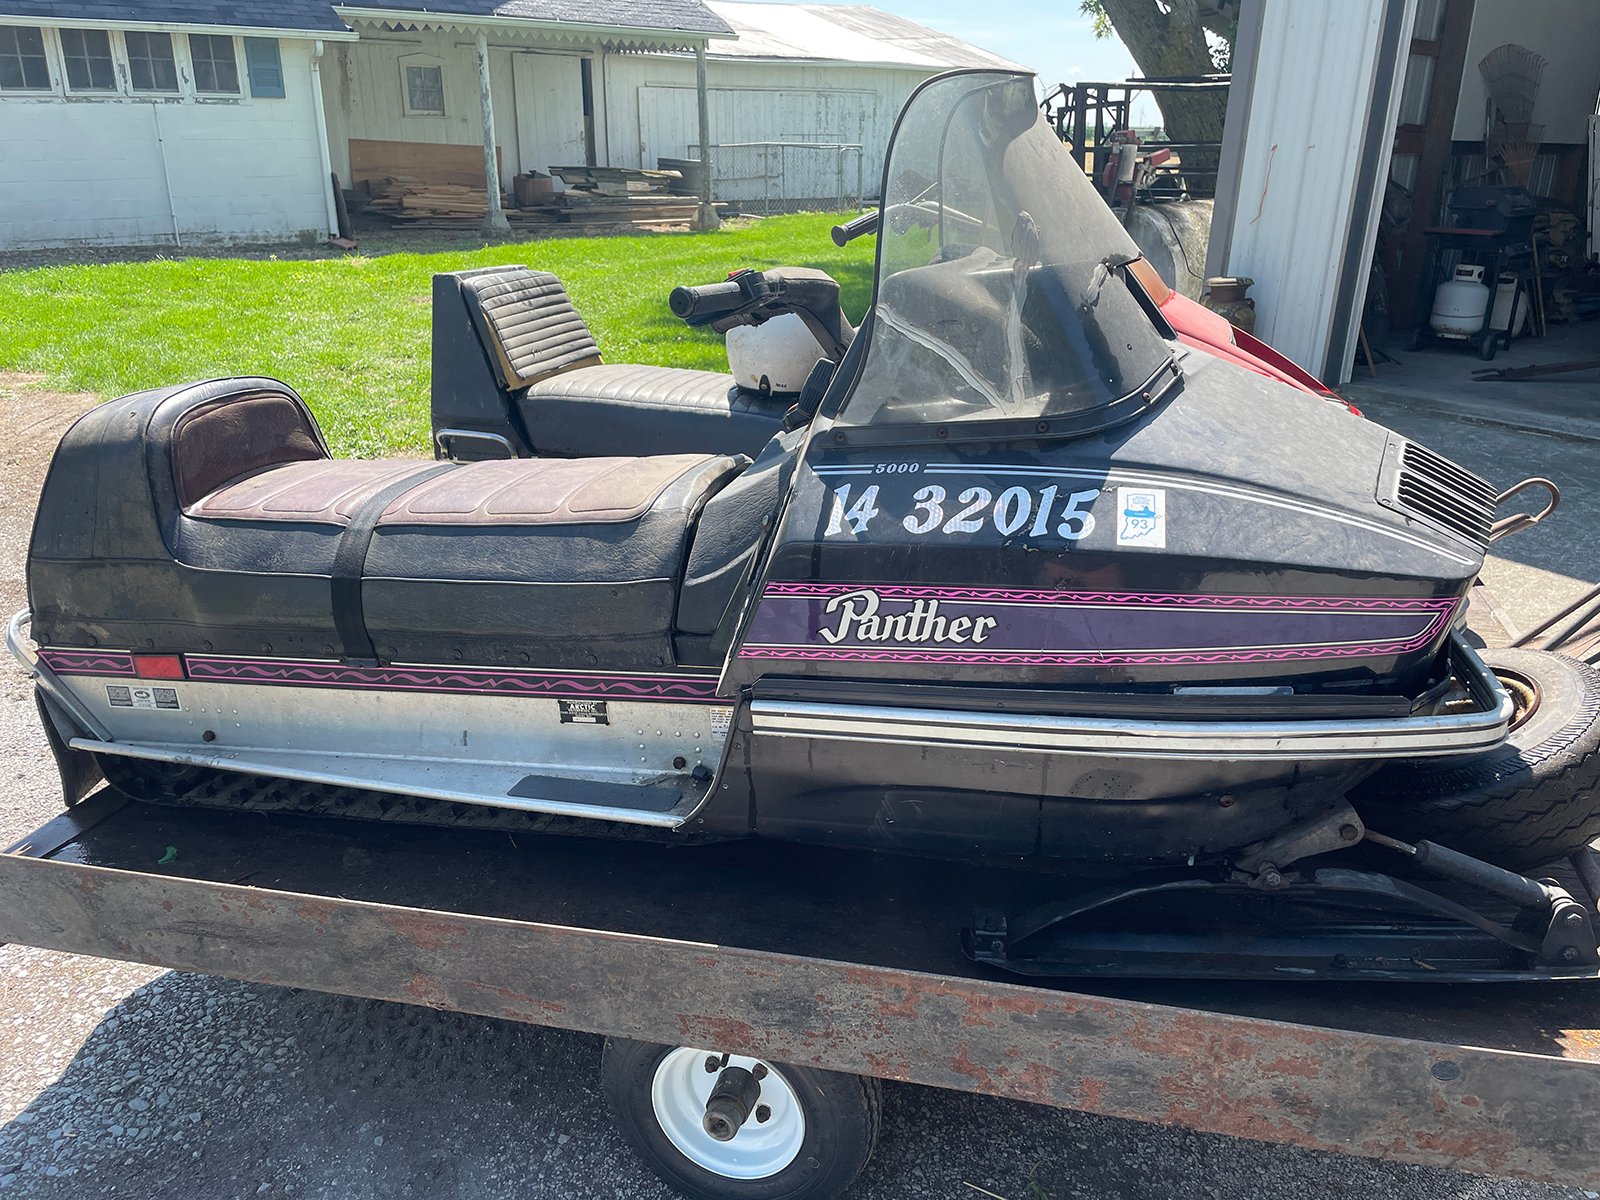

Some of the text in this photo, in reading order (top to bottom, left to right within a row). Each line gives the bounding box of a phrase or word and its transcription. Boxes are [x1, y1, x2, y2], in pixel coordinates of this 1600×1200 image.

[875, 462, 920, 474] 5000
[824, 483, 1100, 540] 14 32015
[1131, 519, 1148, 529] 93
[818, 589, 997, 644] Panther
